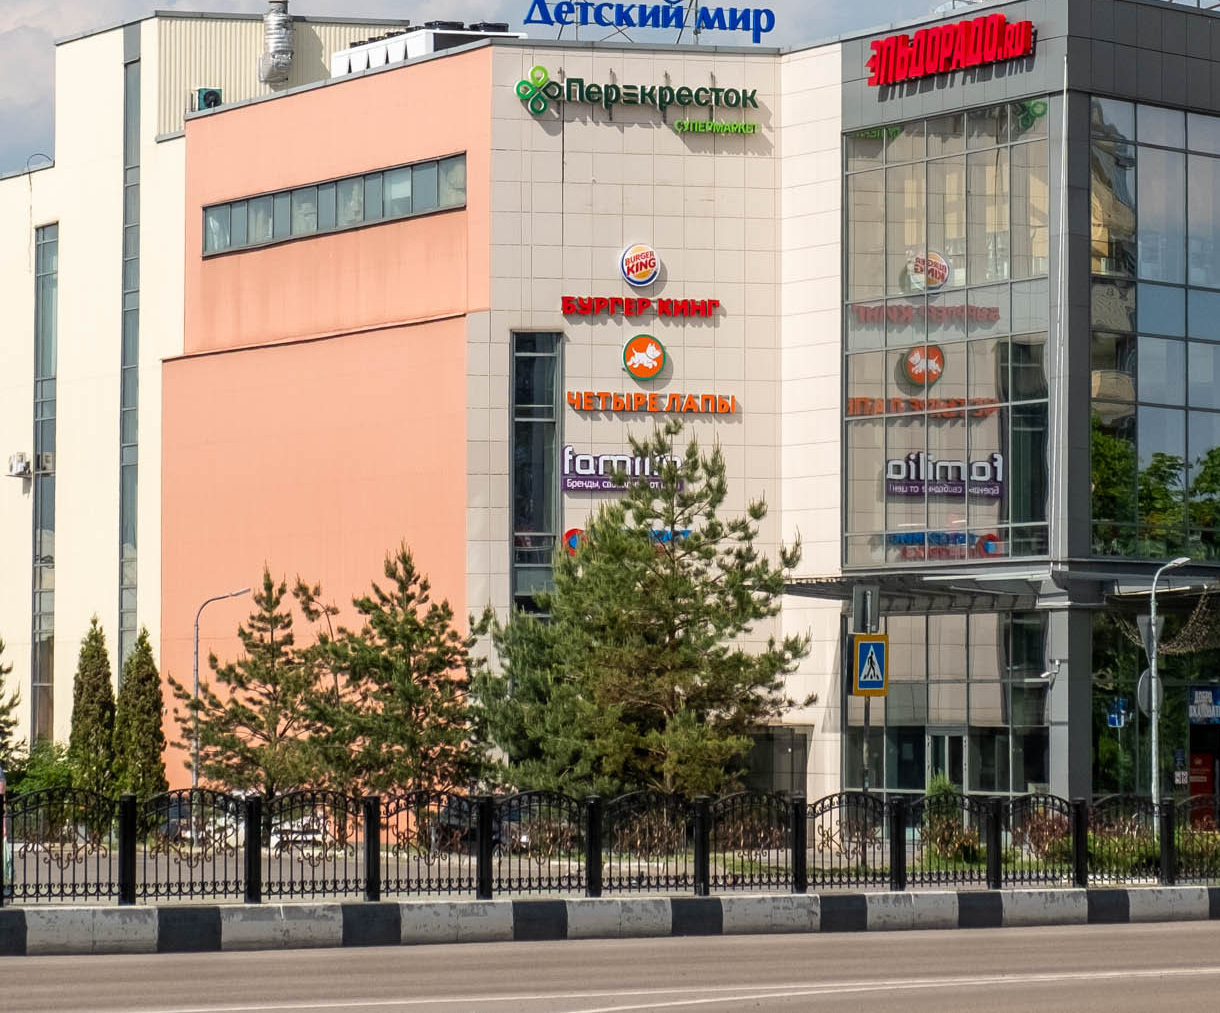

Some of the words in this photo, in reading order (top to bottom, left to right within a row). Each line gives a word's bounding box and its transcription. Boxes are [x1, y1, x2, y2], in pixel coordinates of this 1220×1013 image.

[696, 4, 775, 43] мир
[674, 119, 760, 134] СУПЕРМАРКЕТ
[625, 250, 655, 266] BURGER
[626, 258, 656, 276] KING
[562, 296, 652, 316] БУРГЕР
[657, 298, 720, 317] КИНГ
[566, 391, 659, 412] ЧЕТЫРЕ
[665, 394, 736, 414] ЛАПЫ
